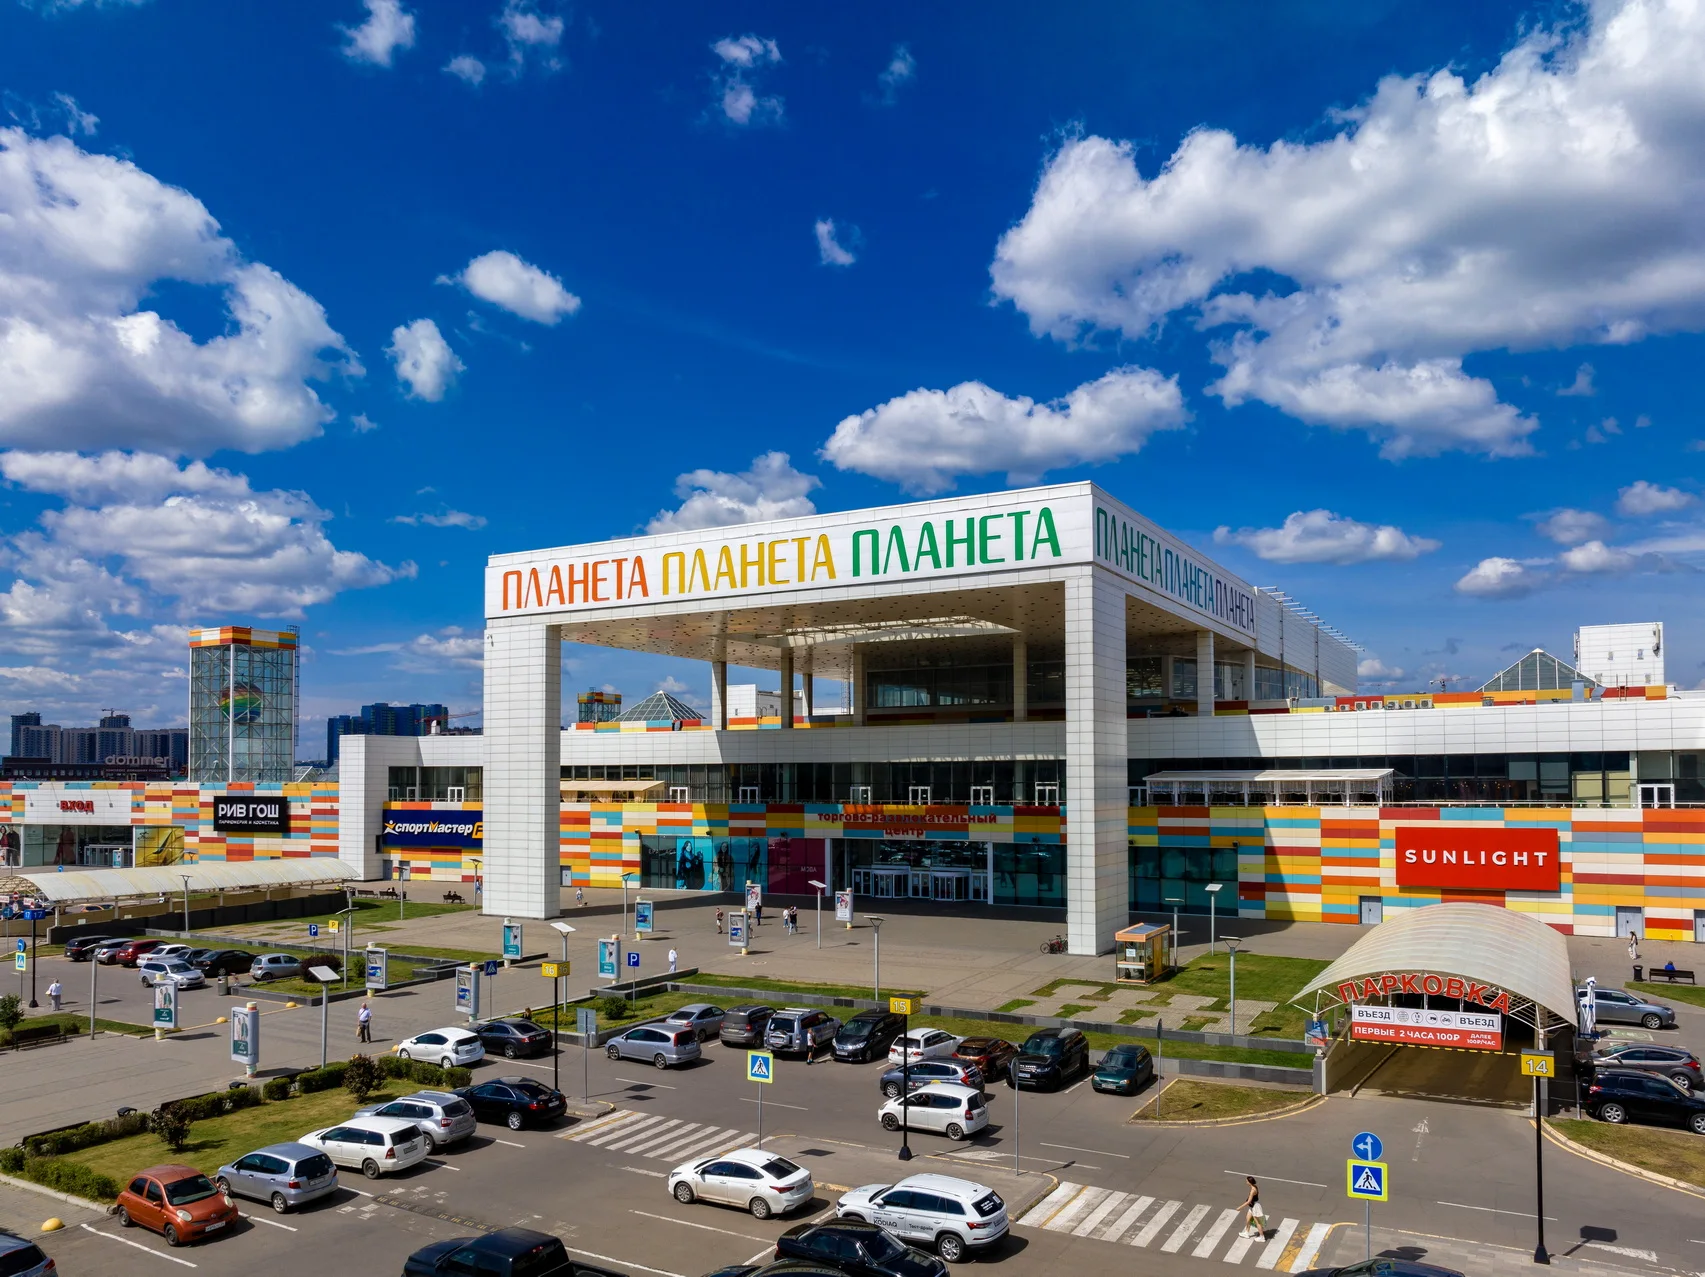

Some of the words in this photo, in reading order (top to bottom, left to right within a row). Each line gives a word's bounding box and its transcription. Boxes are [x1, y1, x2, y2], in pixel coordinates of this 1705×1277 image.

[502, 555, 649, 611] ПЛАНЕТА
[662, 533, 837, 596] ПЛАНЕТА
[852, 506, 1062, 578] ПЛАНЕТА
[1096, 506, 1163, 589] ПЛАНЕТА
[1164, 548, 1215, 614] ПЛАНЕТА
[1215, 579, 1255, 633] ПЛАНЕТА
[105, 754, 169, 766] dommer
[60, 800, 95, 813] ВХОД
[218, 804, 247, 817] РИВ
[249, 804, 279, 818] ГОШ
[817, 812, 997, 824] торгово-развлекательный
[885, 826, 925, 837] центр
[1405, 849, 1548, 867] SUNLIGHT
[34, 911, 43, 919] 17
[311, 925, 317, 935] P
[630, 954, 638, 966] P
[545, 965, 555, 975] 16
[1337, 973, 1509, 1015] ПАРКОВКА
[893, 1000, 907, 1013] 15
[1358, 1010, 1391, 1020] ВЪЕЗД
[1460, 1017, 1495, 1028] ВЪЕЗД
[1354, 1026, 1395, 1037] ПЕРВЫЕ
[1407, 1031, 1435, 1040] ЧАСА
[1526, 1059, 1548, 1074] 14
